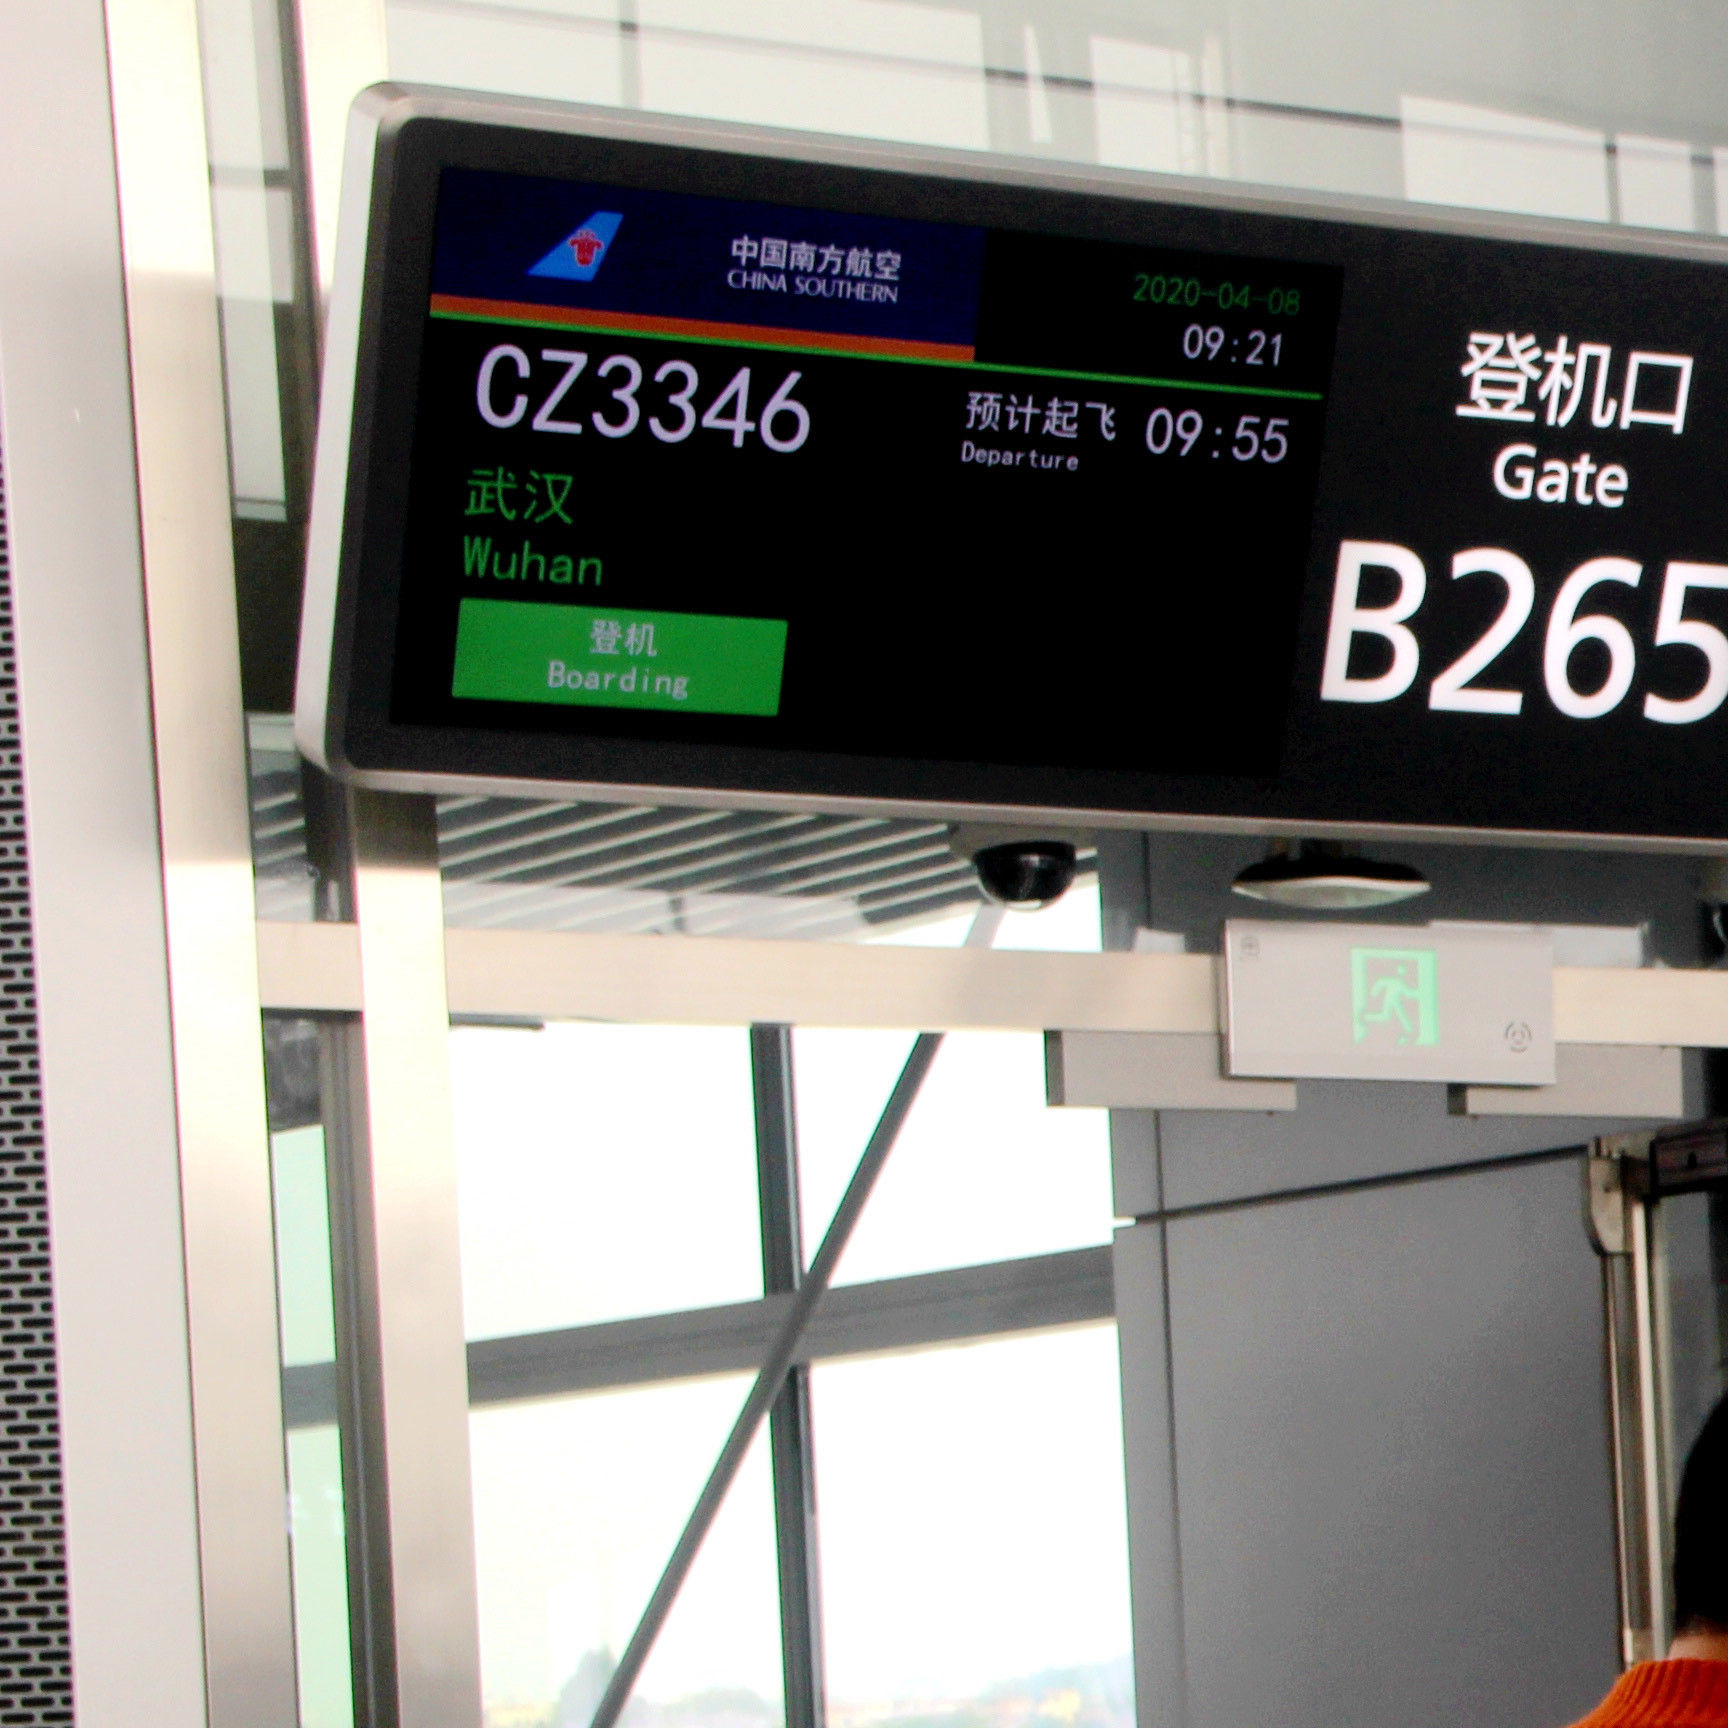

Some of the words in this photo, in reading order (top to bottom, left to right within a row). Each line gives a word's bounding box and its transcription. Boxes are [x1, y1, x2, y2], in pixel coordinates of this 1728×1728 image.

[729, 235, 901, 282] 中国南方航空
[727, 271, 788, 294] CHINA
[795, 276, 899, 304] SOUTHERN
[1132, 273, 1300, 316] 2020-04-08
[1183, 323, 1283, 367] 09:21
[476, 343, 811, 454] CZ3346
[1455, 331, 1694, 434] 登机口
[963, 392, 1117, 444] 预计起飞
[1145, 407, 1289, 464] 09:55
[960, 440, 1079, 472] Departure
[1492, 443, 1630, 509] Gate
[464, 466, 575, 526] 武汉
[462, 535, 604, 587] Wuhan
[589, 620, 658, 658] 登机
[546, 660, 689, 701] Boarding
